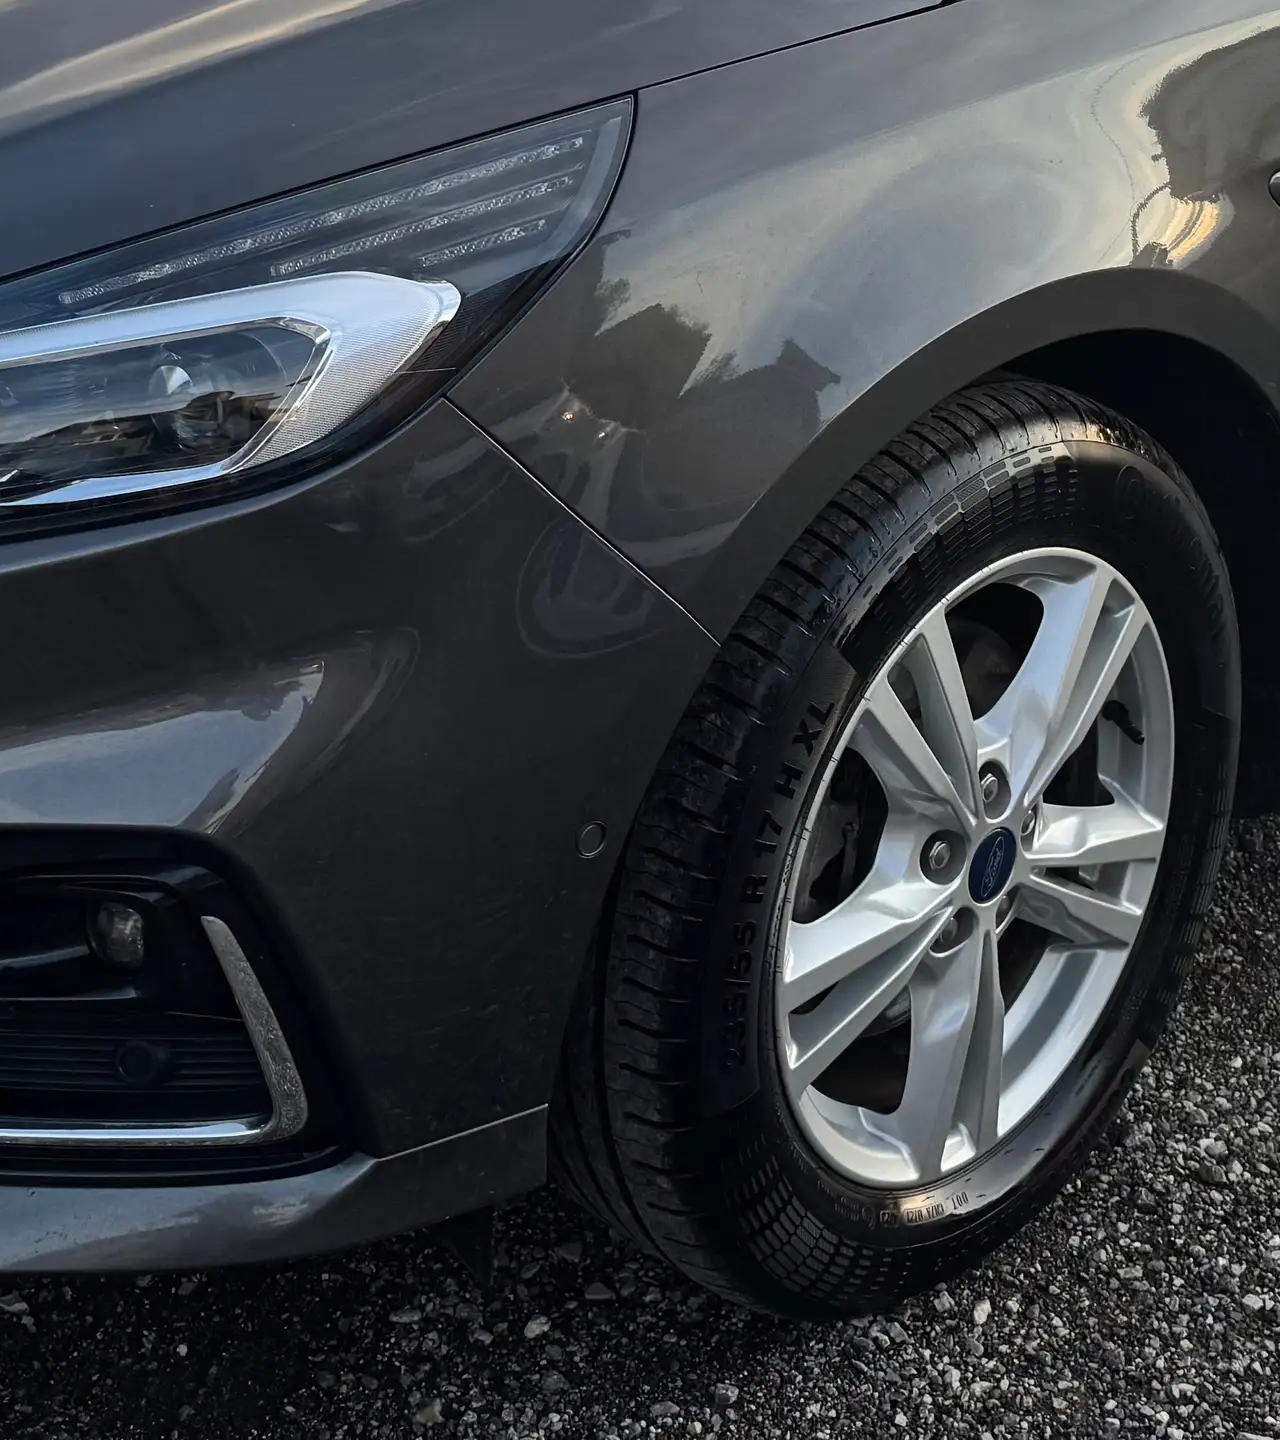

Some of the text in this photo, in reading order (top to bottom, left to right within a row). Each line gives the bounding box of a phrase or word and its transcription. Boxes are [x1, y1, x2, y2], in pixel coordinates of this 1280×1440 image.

[792, 699, 837, 757] XL
[774, 760, 805, 801] H
[752, 808, 784, 860] 17
[740, 872, 769, 904] R
